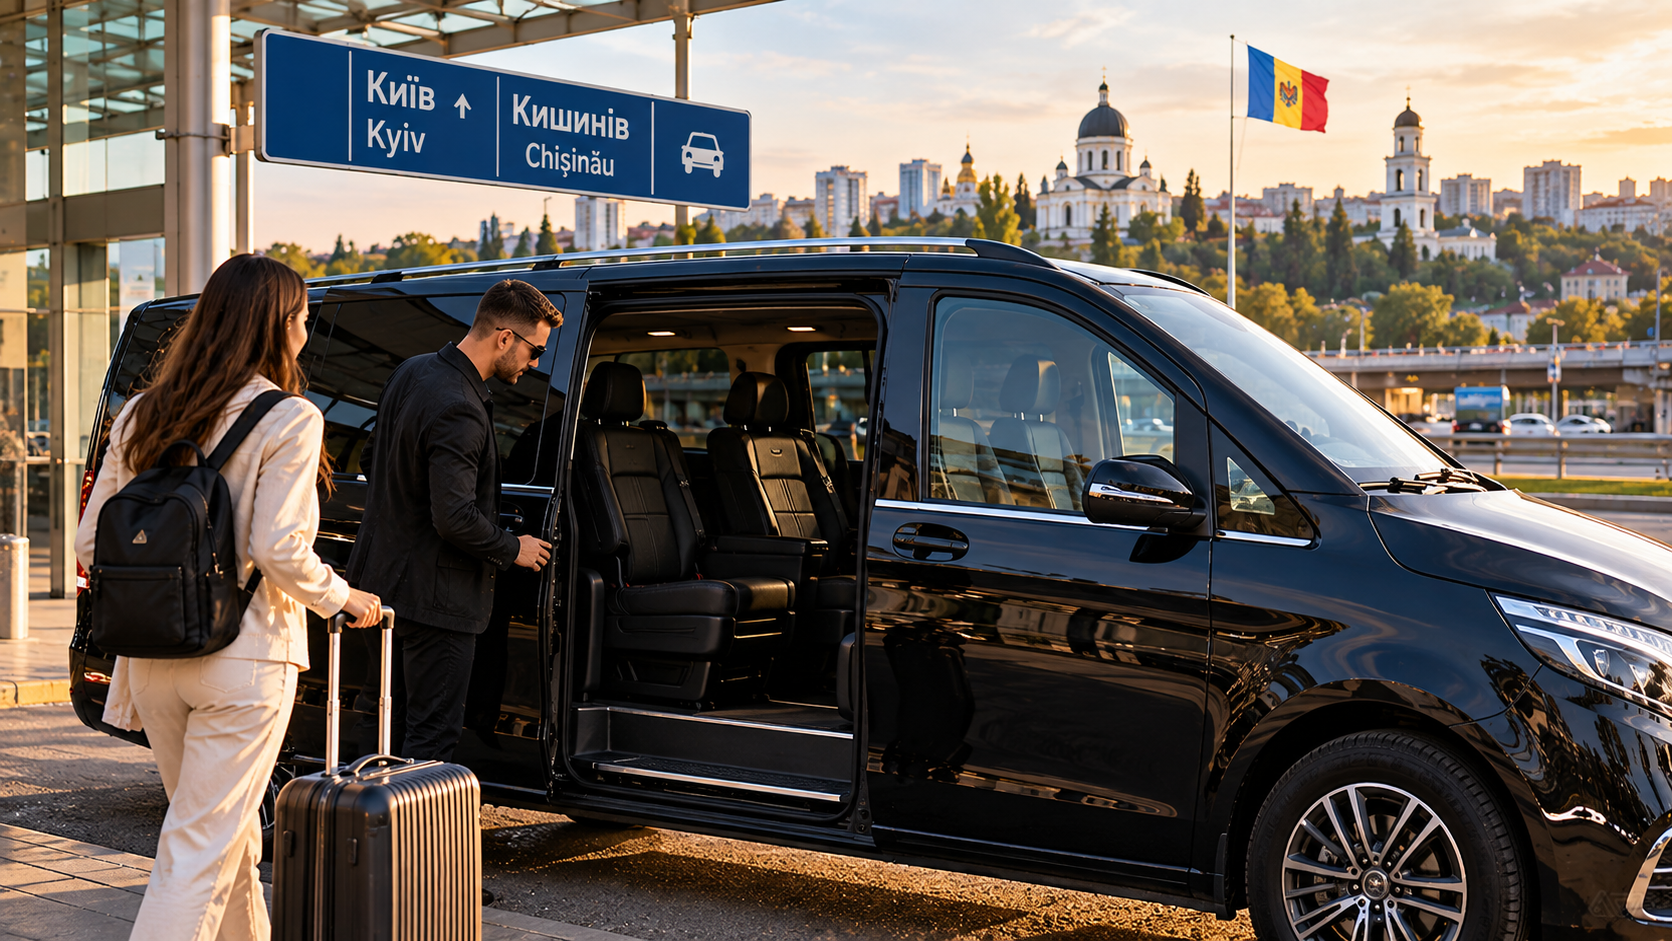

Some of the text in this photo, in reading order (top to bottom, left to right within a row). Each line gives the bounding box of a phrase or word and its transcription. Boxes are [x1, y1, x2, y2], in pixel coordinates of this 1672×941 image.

[367, 69, 436, 111] Київ
[512, 94, 630, 140] Кишинів
[367, 119, 426, 158] Kyiv
